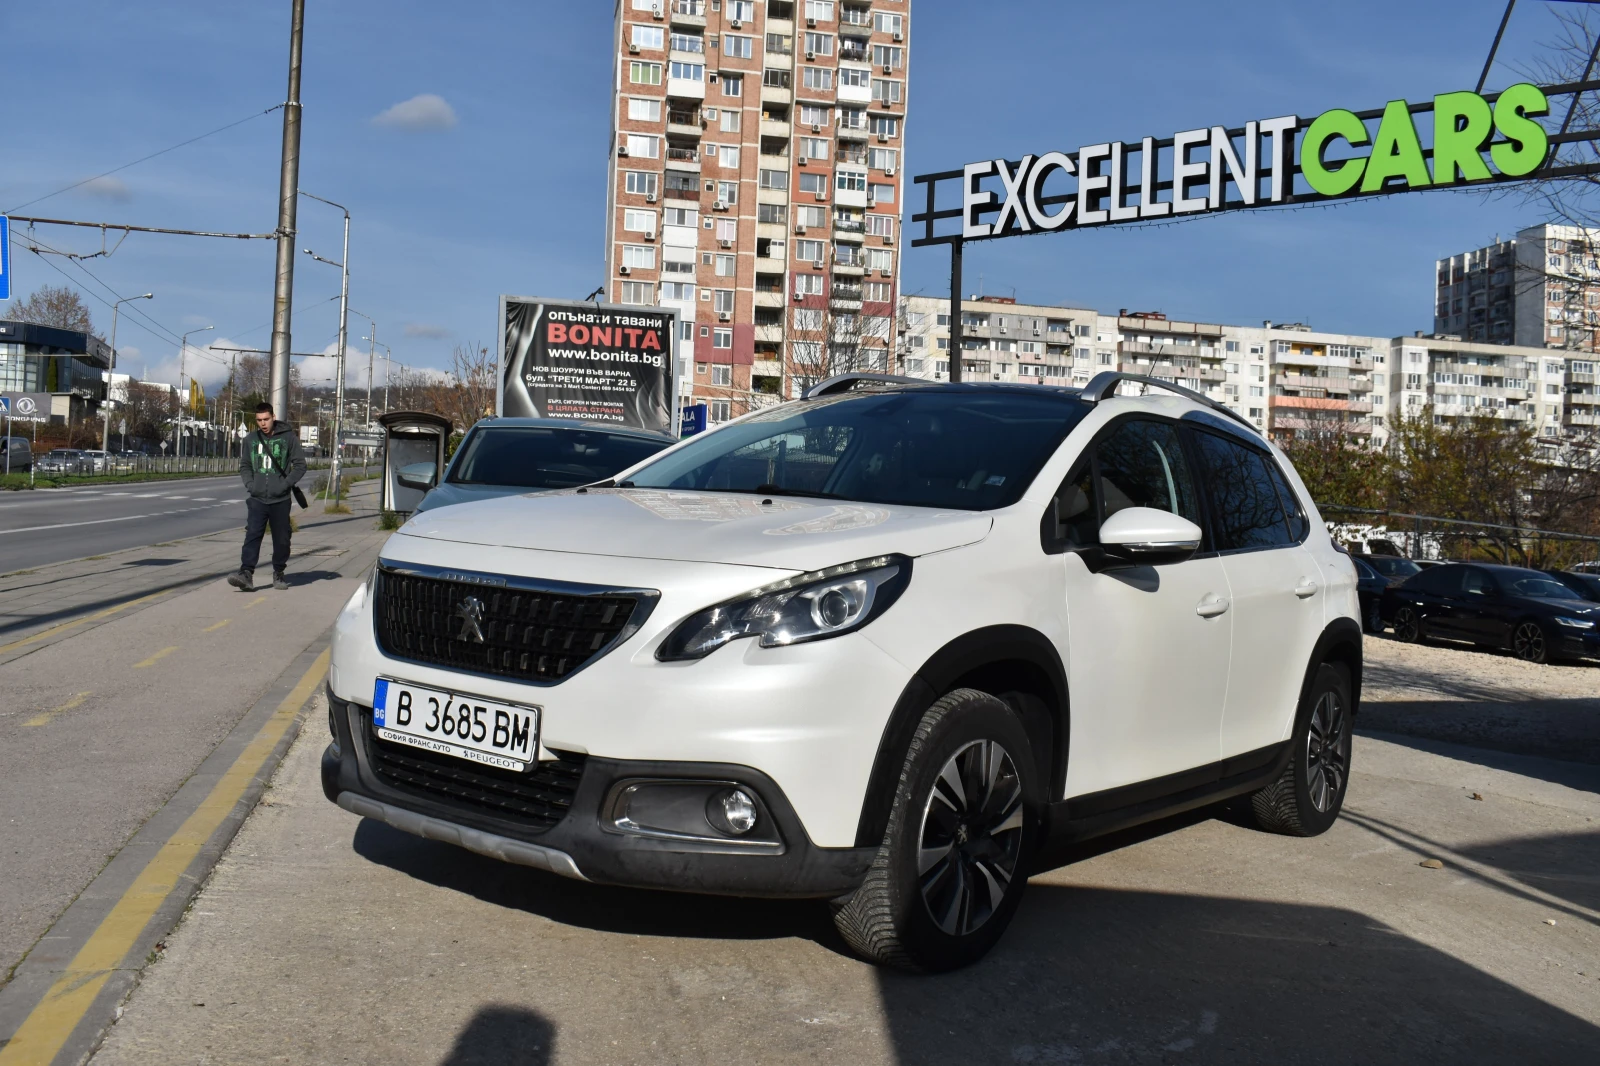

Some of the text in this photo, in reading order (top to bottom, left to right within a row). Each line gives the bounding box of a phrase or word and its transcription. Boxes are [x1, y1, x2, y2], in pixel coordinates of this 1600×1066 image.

[962, 83, 1550, 238] EXCELLENT CARS
[548, 311, 662, 328] опънати тавани
[548, 323, 661, 350] BONITA
[548, 348, 661, 366] www.bonita.bg
[548, 413, 624, 421] www.BONITA.bg
[375, 708, 385, 720] BG
[397, 690, 412, 726] B
[425, 697, 487, 743] 3685
[383, 731, 450, 752] СОФИЯ ФРАНС АУТО
[470, 752, 516, 768] PEUGEOT
